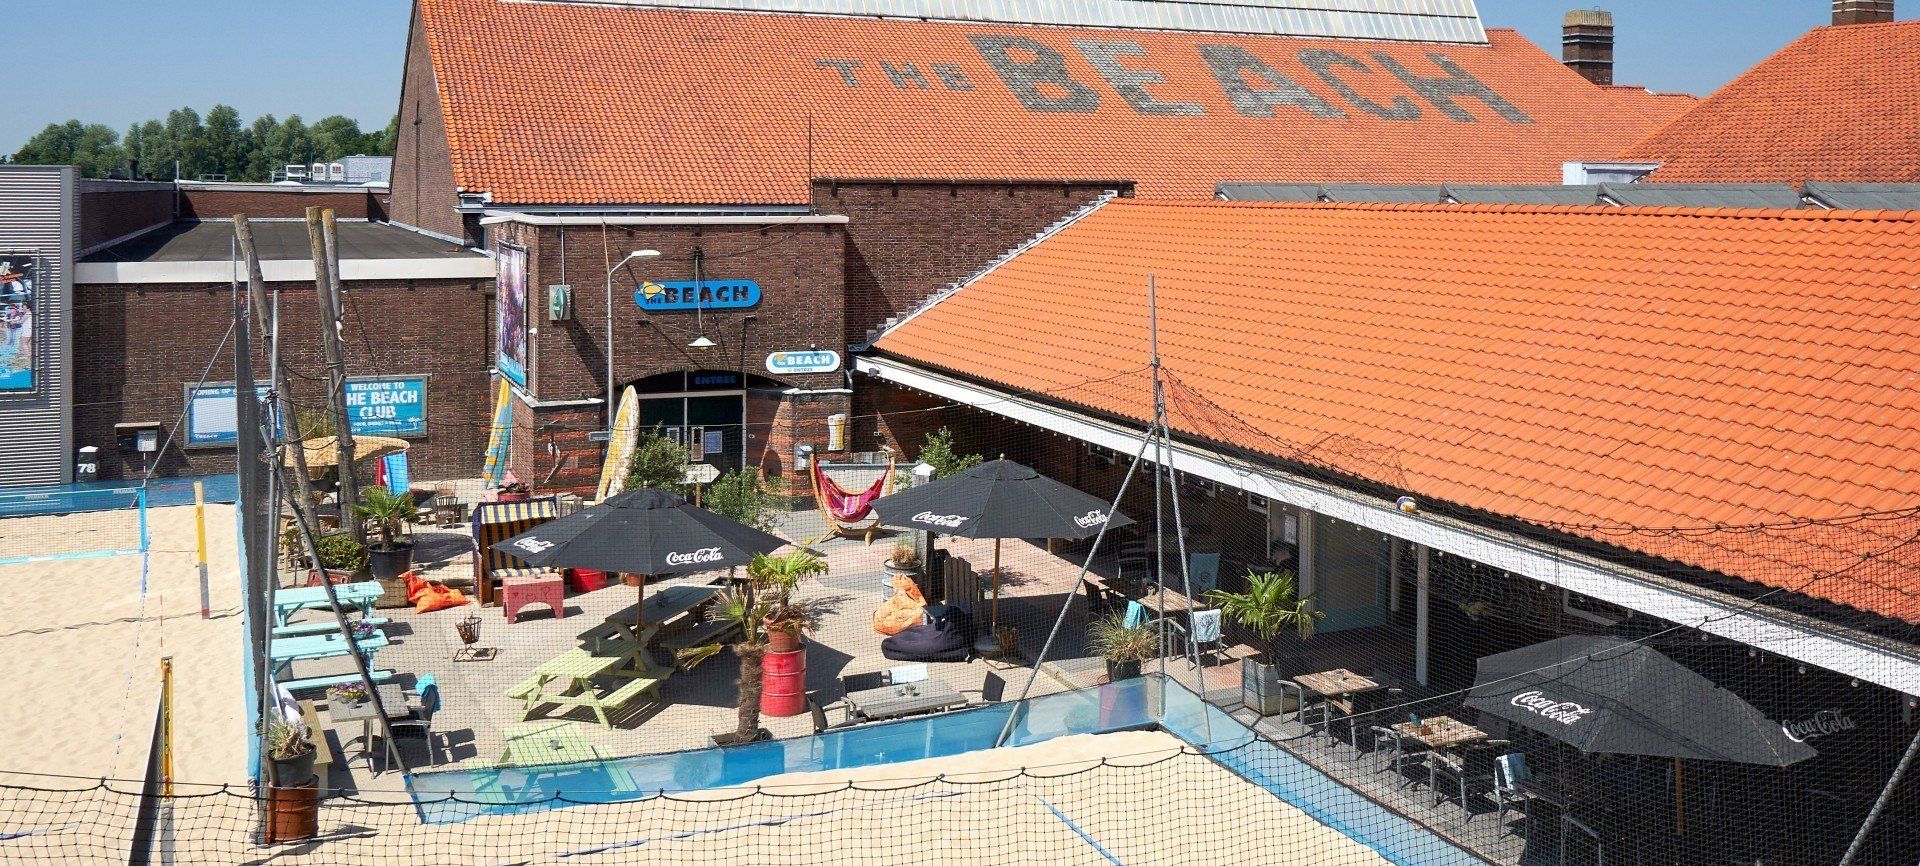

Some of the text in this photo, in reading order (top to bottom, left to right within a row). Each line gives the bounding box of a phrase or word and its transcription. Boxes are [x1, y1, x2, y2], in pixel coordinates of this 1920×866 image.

[814, 34, 1535, 124] THE BEACH
[664, 285, 749, 304] BEACH
[787, 355, 830, 366] BEACH
[350, 382, 391, 391] WELCOME
[695, 376, 737, 385] ENTREE
[346, 390, 418, 406] HE BEACH
[359, 406, 397, 420] CLUB
[78, 463, 96, 473] 78
[912, 510, 970, 528] Coca-Cola
[666, 546, 724, 565] Coca-Cola
[1510, 690, 1593, 725] Coca-Cola
[1781, 707, 1856, 742] Coca-Cola
